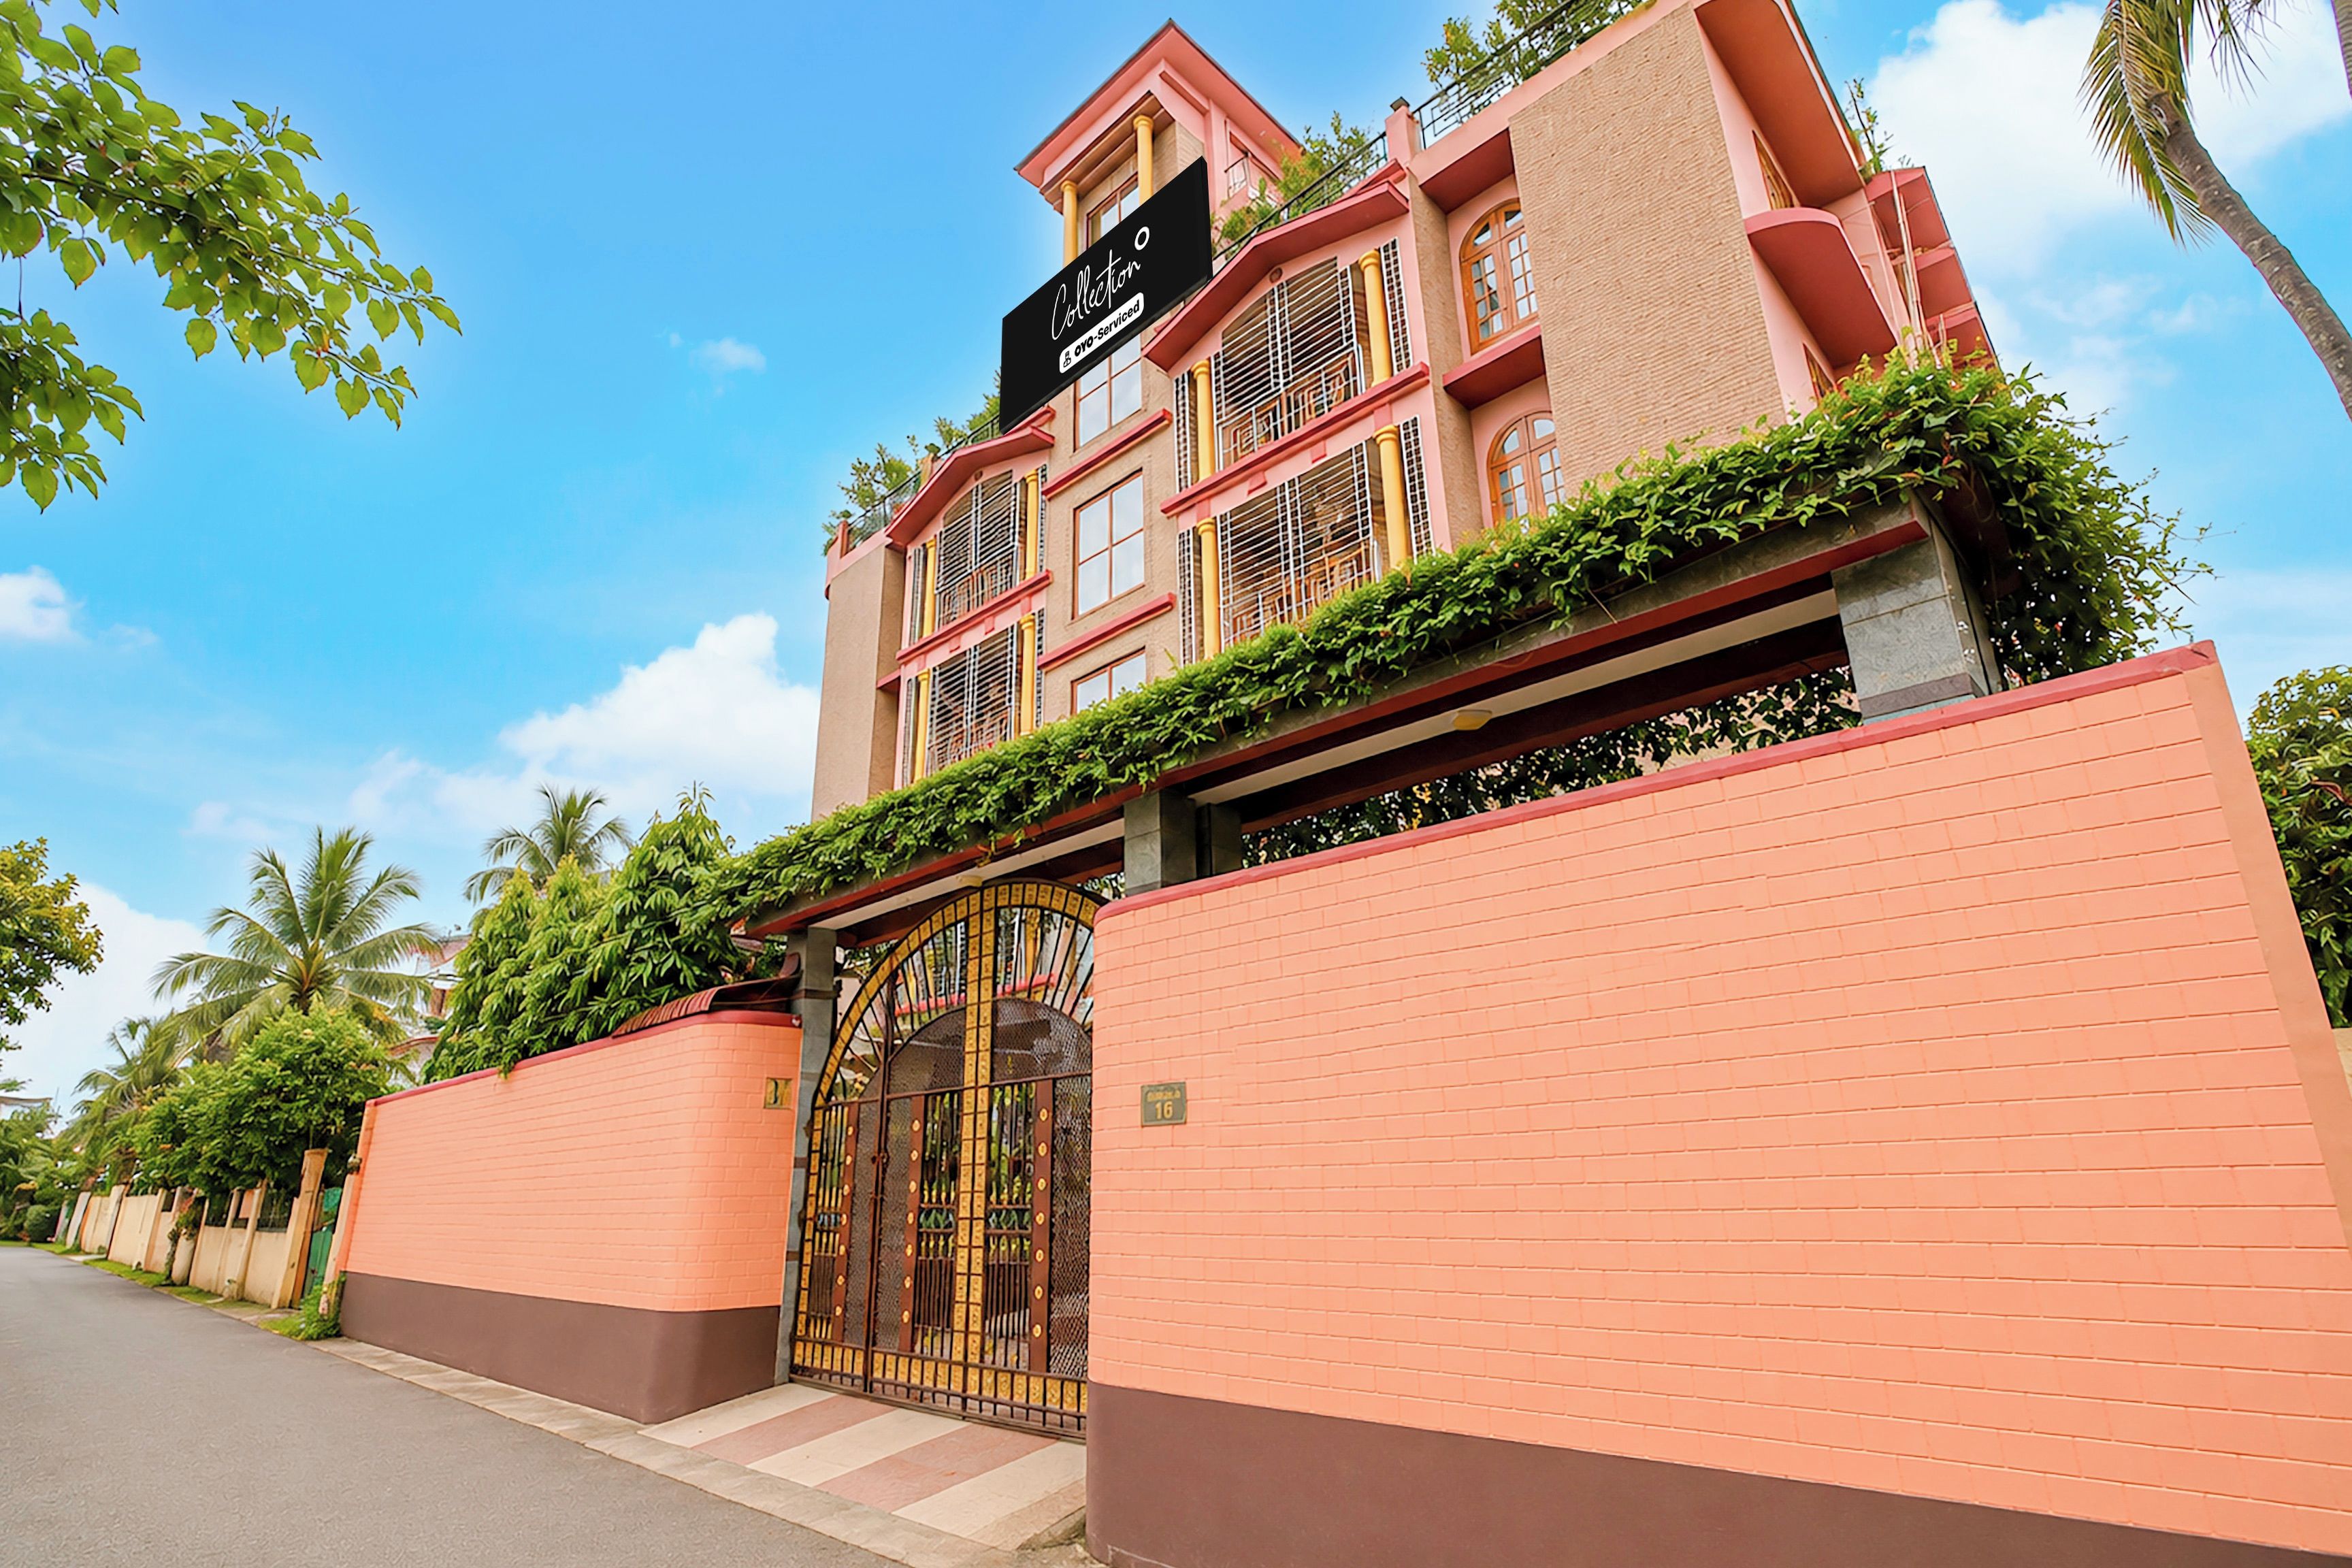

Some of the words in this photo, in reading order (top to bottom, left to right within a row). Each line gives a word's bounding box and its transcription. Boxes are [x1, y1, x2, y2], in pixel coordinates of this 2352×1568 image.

[1051, 249, 1141, 341] Collection
[1074, 299, 1140, 358] OYO-Serviced
[1155, 1100, 1173, 1120] 16
